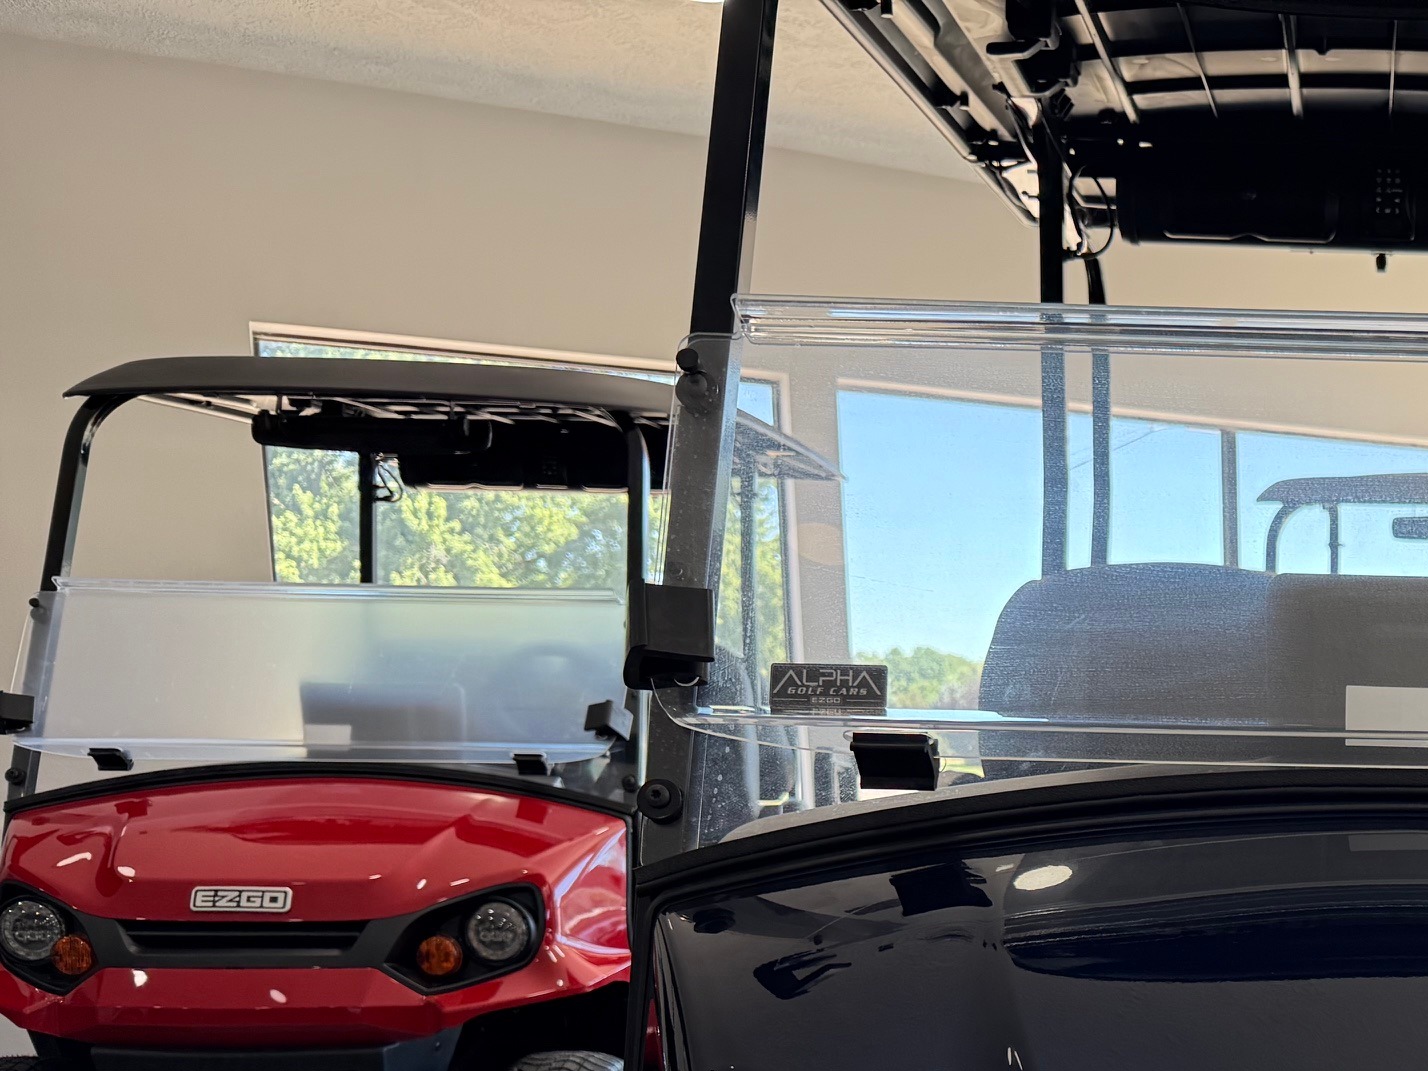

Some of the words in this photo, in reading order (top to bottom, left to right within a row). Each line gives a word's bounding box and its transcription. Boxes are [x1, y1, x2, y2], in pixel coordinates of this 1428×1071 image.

[772, 668, 882, 696] ALPHA
[787, 686, 825, 695] GOLF
[829, 686, 868, 696] CARS
[194, 889, 287, 910] EZGO
